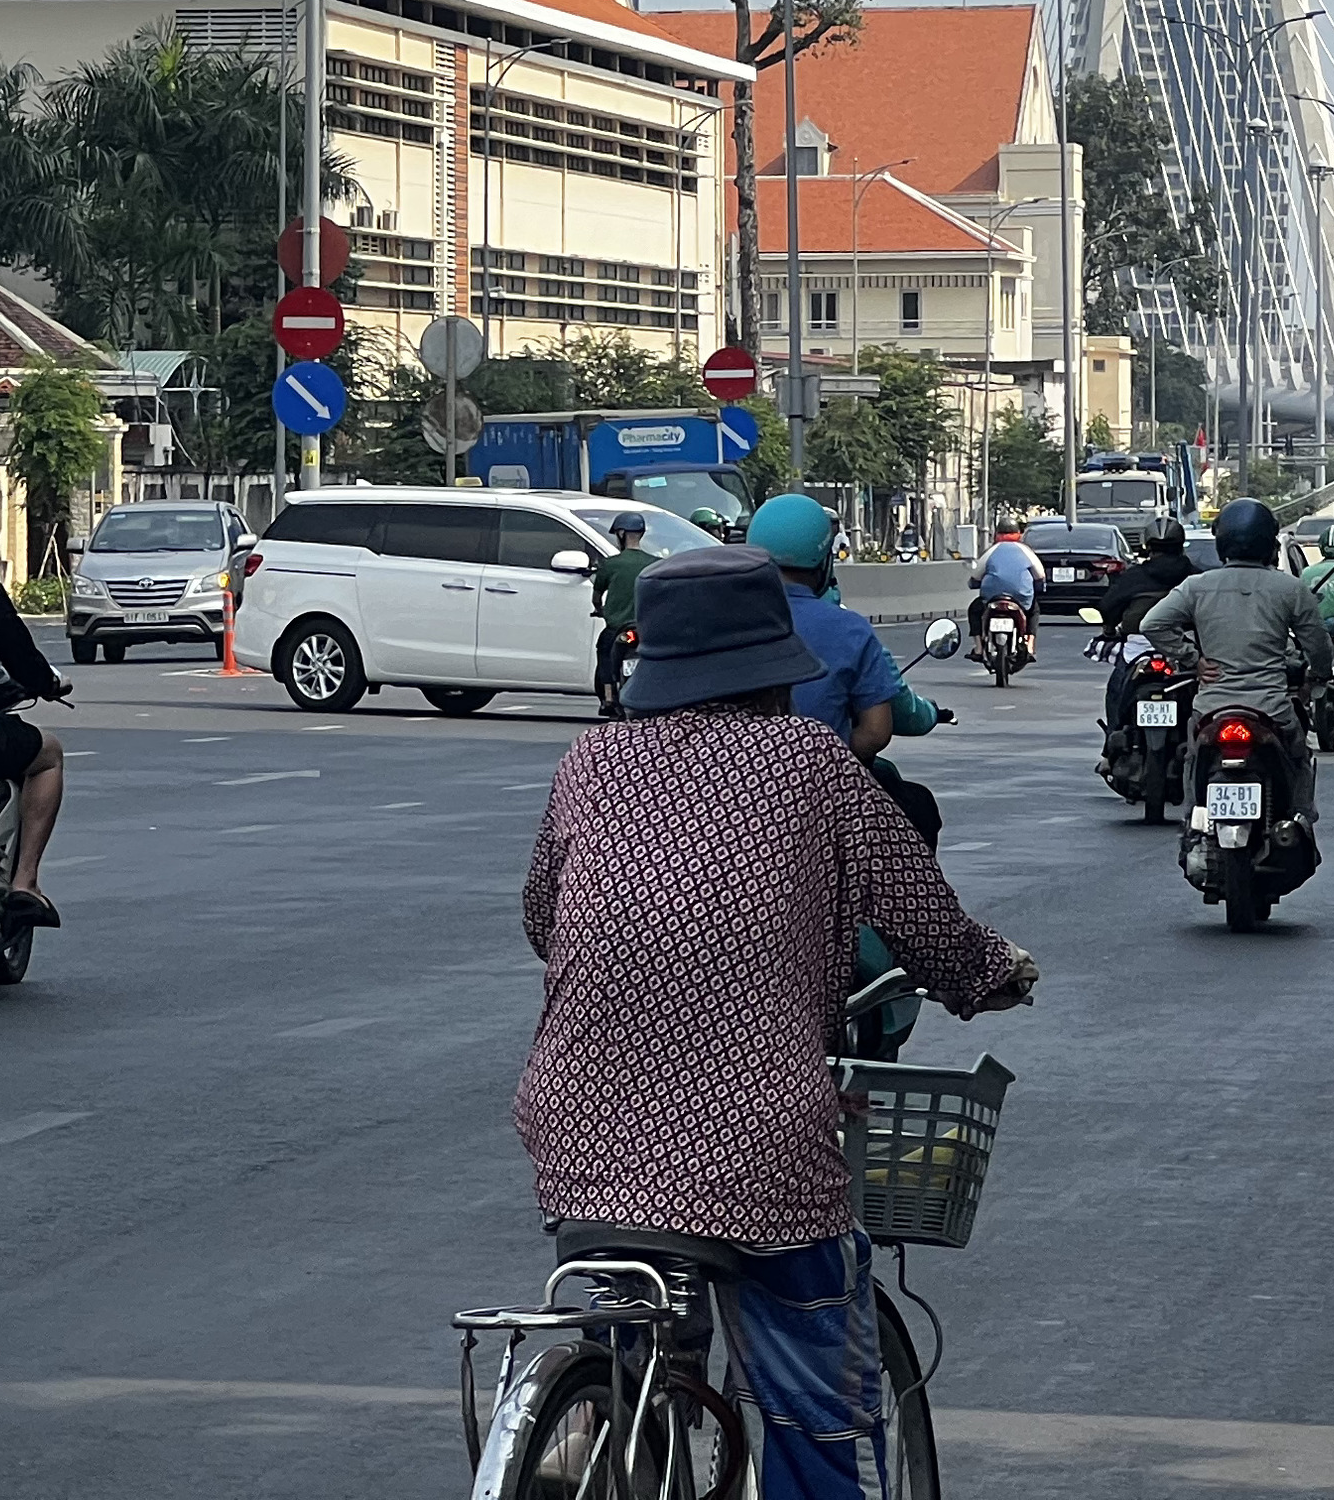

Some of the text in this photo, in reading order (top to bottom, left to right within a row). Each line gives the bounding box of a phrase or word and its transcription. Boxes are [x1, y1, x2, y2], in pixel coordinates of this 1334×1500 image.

[622, 426, 681, 445] Pharmacity
[1143, 703, 1170, 714] 59-H1
[1215, 787, 1252, 801] 34-B1
[1211, 802, 1258, 816] 394.59
